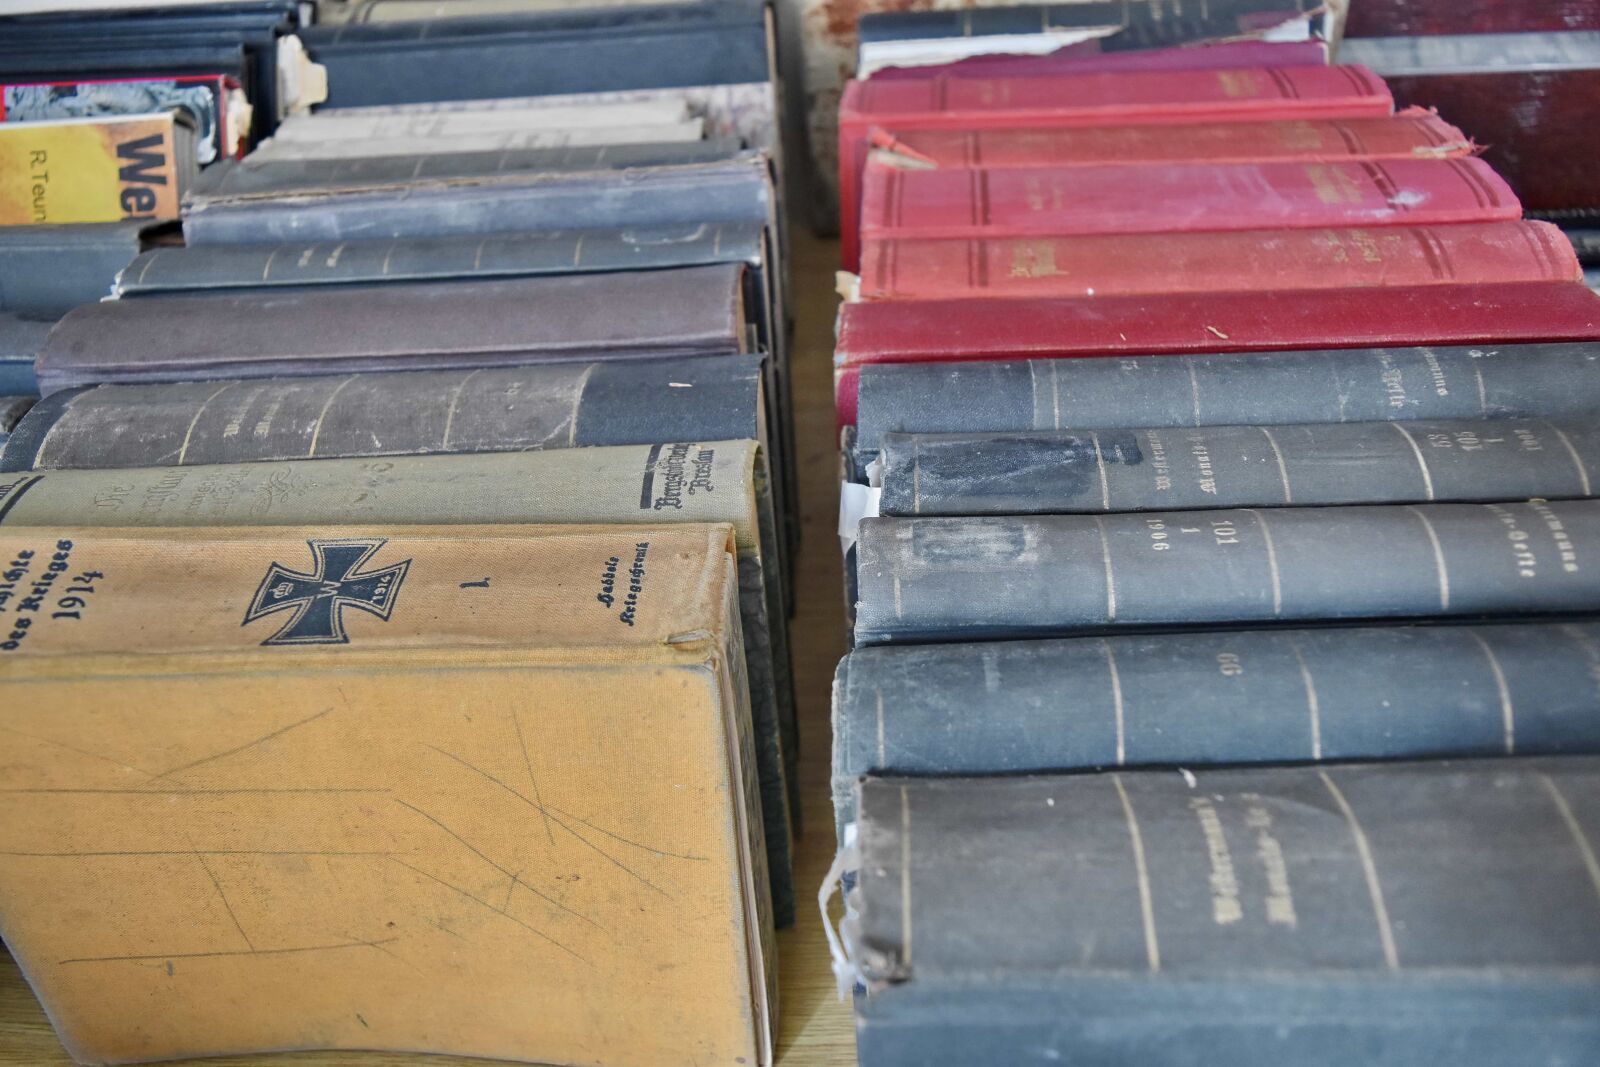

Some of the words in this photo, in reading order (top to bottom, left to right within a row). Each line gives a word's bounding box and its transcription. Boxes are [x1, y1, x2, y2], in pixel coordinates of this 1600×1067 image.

[1146, 519, 1170, 551] 1906
[1210, 520, 1239, 546] 101
[16, 539, 74, 613] Krieges
[52, 571, 104, 621] 1914
[619, 541, 650, 627] Kriegschronik
[1216, 653, 1243, 676] 66
